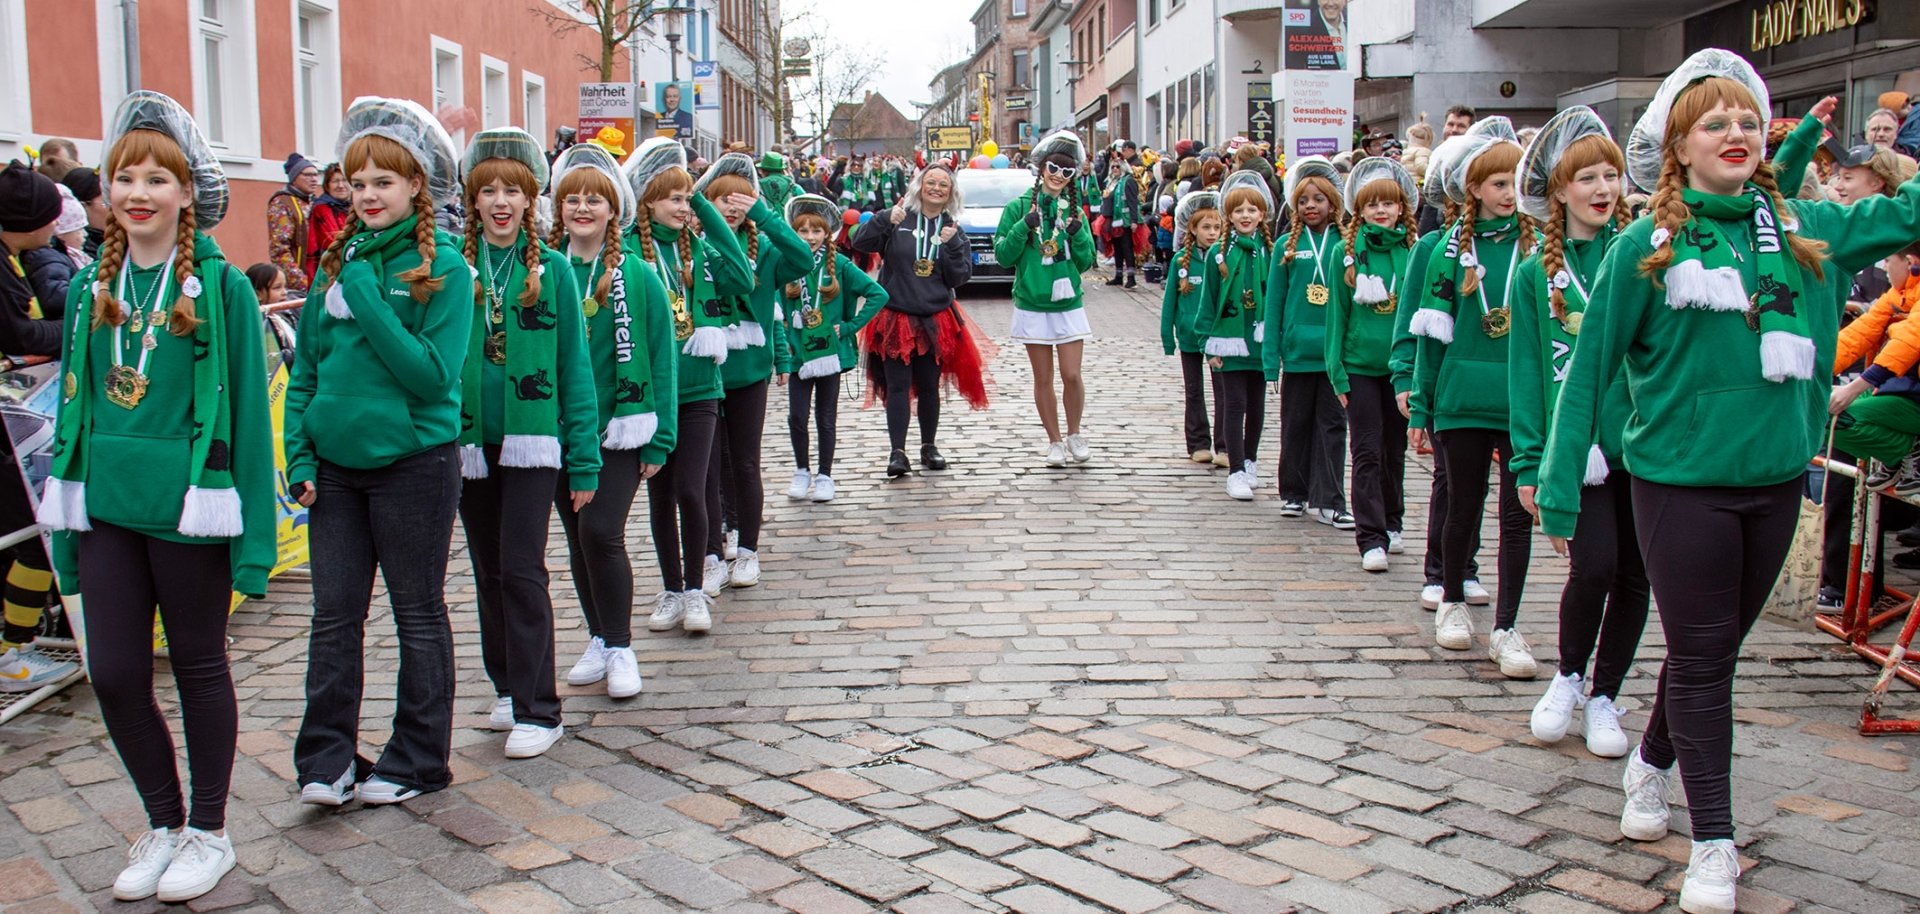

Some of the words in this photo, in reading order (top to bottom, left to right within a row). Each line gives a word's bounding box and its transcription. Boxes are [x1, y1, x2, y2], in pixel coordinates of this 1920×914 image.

[1289, 12, 1306, 21] SPD
[1751, 0, 1797, 51] LADY
[1802, 0, 1863, 38] NAILS
[1288, 34, 1343, 44] ALEXANDER
[1288, 44, 1345, 53] SCHWEITZER
[1253, 59, 1262, 71] 2
[580, 85, 626, 97] Wahrheit
[580, 98, 595, 107] statt
[595, 97, 630, 107] Corona-
[1292, 106, 1348, 115] Gesundheits
[1293, 116, 1346, 126] versorgung.
